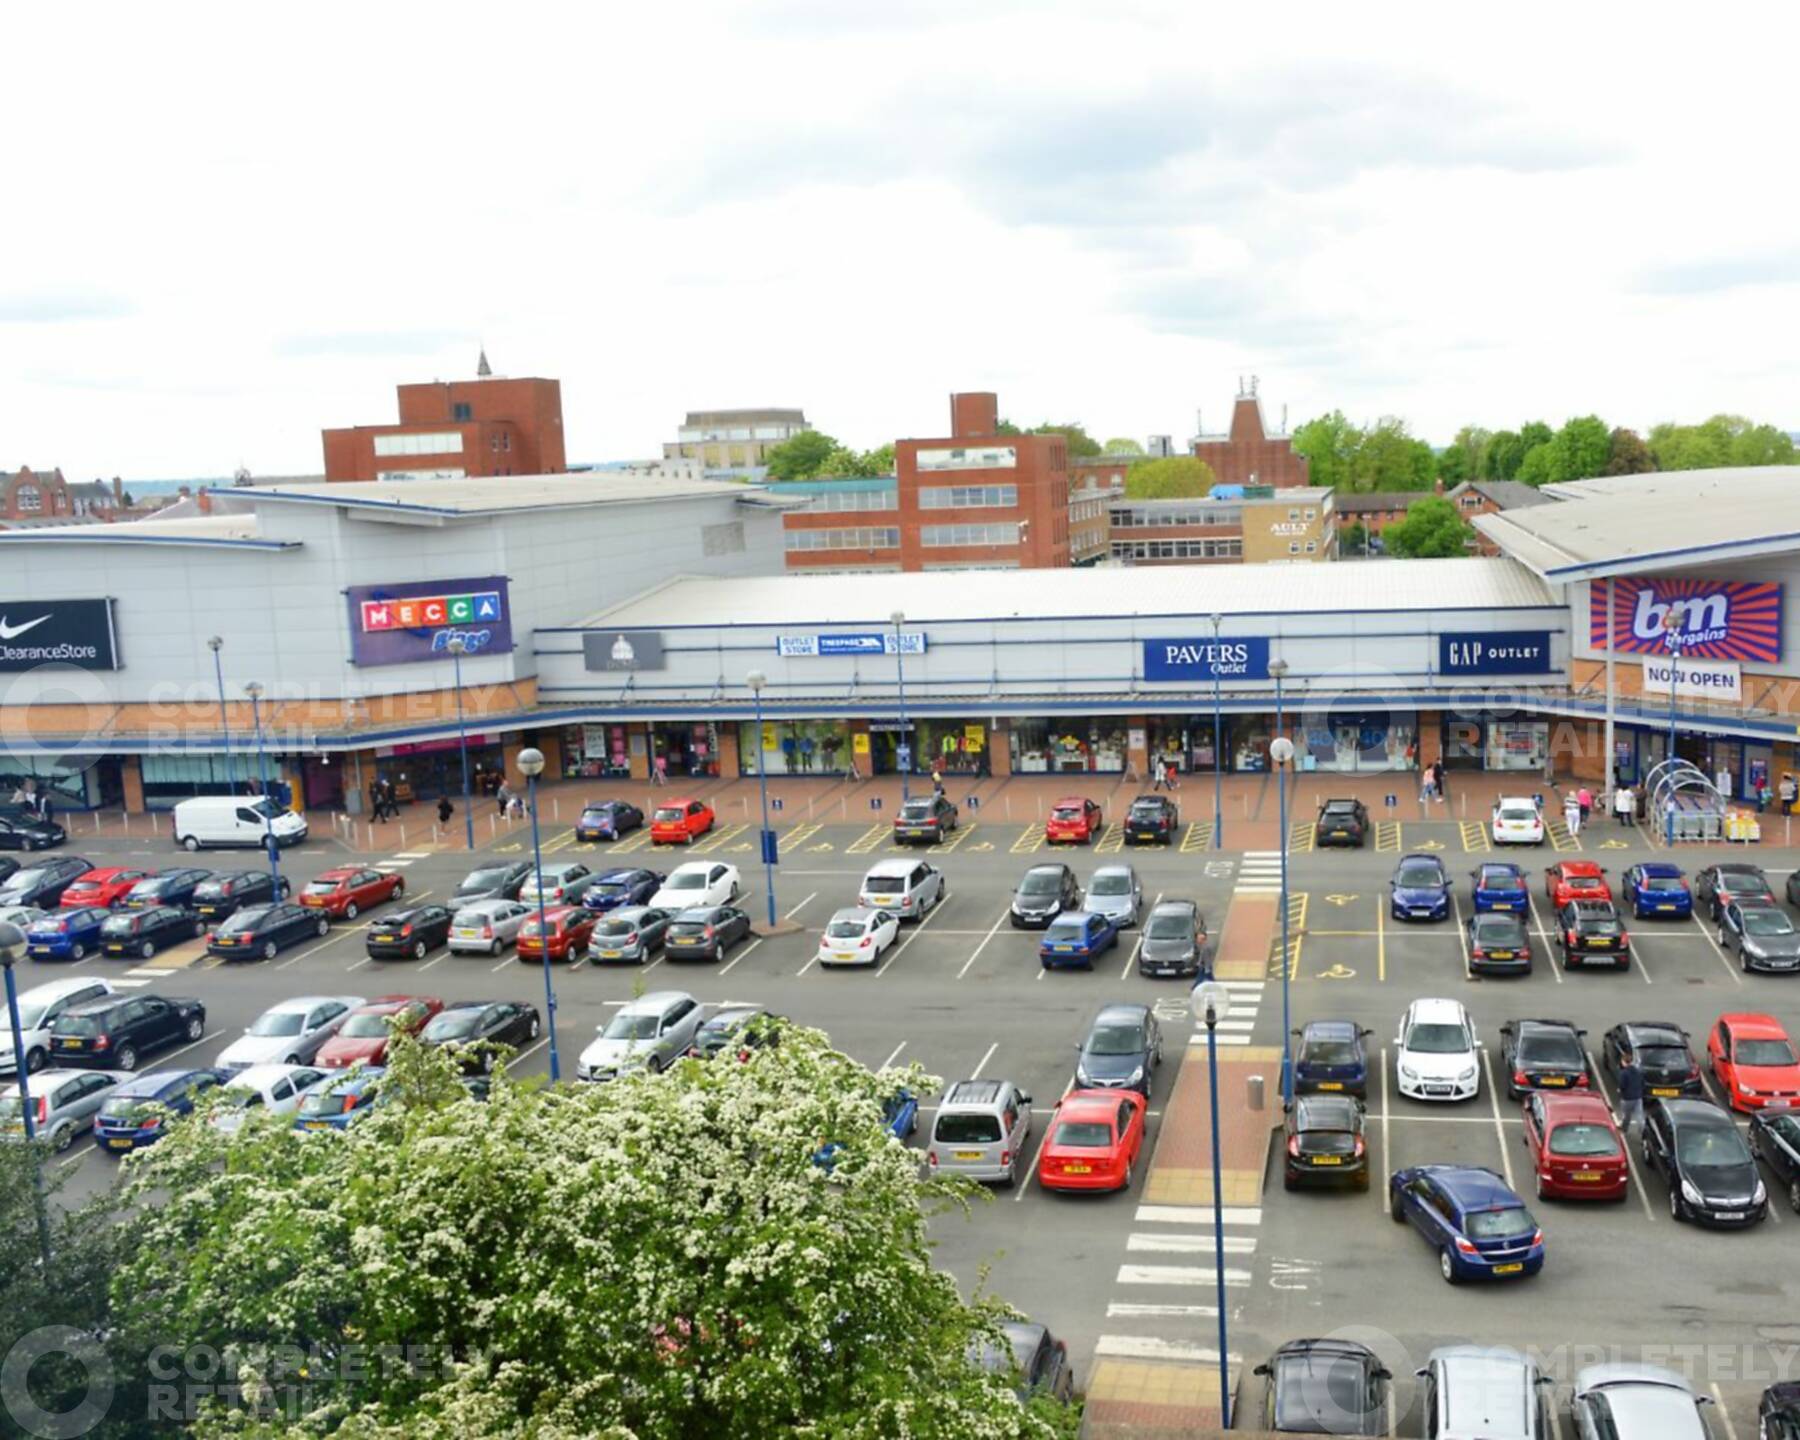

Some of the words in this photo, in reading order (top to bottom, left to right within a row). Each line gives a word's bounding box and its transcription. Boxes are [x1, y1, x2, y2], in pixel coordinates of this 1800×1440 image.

[370, 600, 495, 625] MECCA
[1165, 644, 1248, 665] PAVERS
[1449, 641, 1482, 666] GAP
[1488, 647, 1540, 659] OUTLET
[1210, 663, 1248, 674] Outlet
[1648, 667, 1686, 684] NOW
[1690, 671, 1735, 689] OPEN
